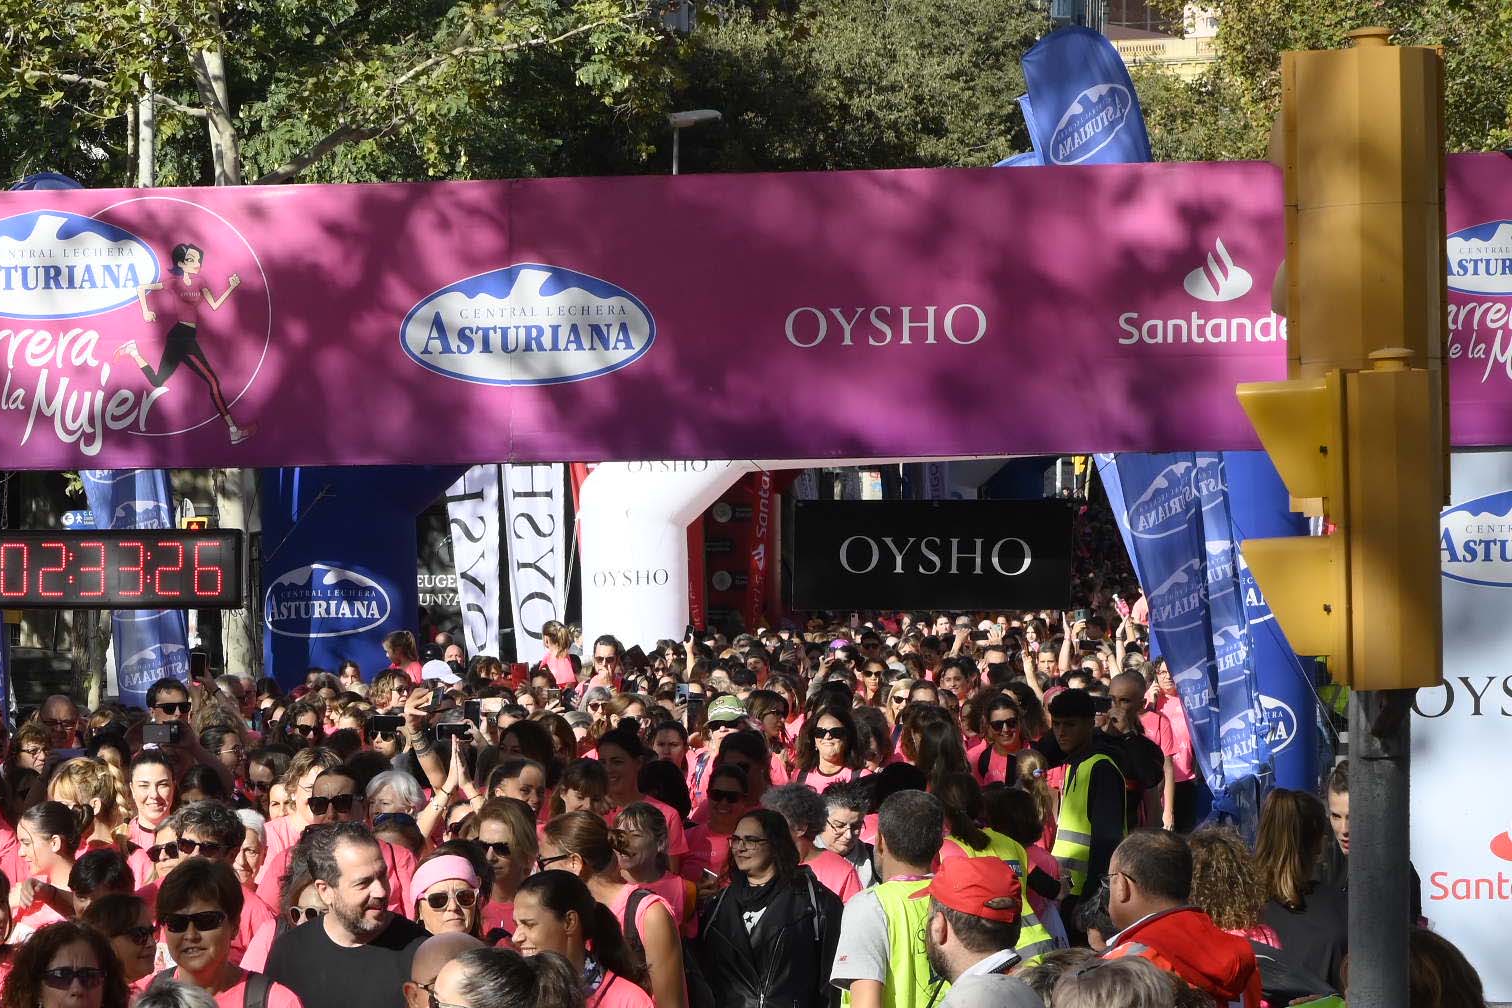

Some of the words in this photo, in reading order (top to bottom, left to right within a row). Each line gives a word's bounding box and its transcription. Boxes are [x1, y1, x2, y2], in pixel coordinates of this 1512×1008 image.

[459, 305, 542, 320] CENTRAL
[547, 304, 627, 317] LECHERA
[784, 303, 989, 349] OYSHO
[1118, 311, 1288, 345] Santande
[420, 310, 636, 356] ASTURIANA
[0, 370, 27, 411] la
[20, 365, 171, 457] Mujer
[0, 542, 222, 597] 02:33:26
[839, 535, 1034, 576] OYSHO
[593, 568, 670, 587] OYSHO
[268, 594, 380, 621] ASTURIANA
